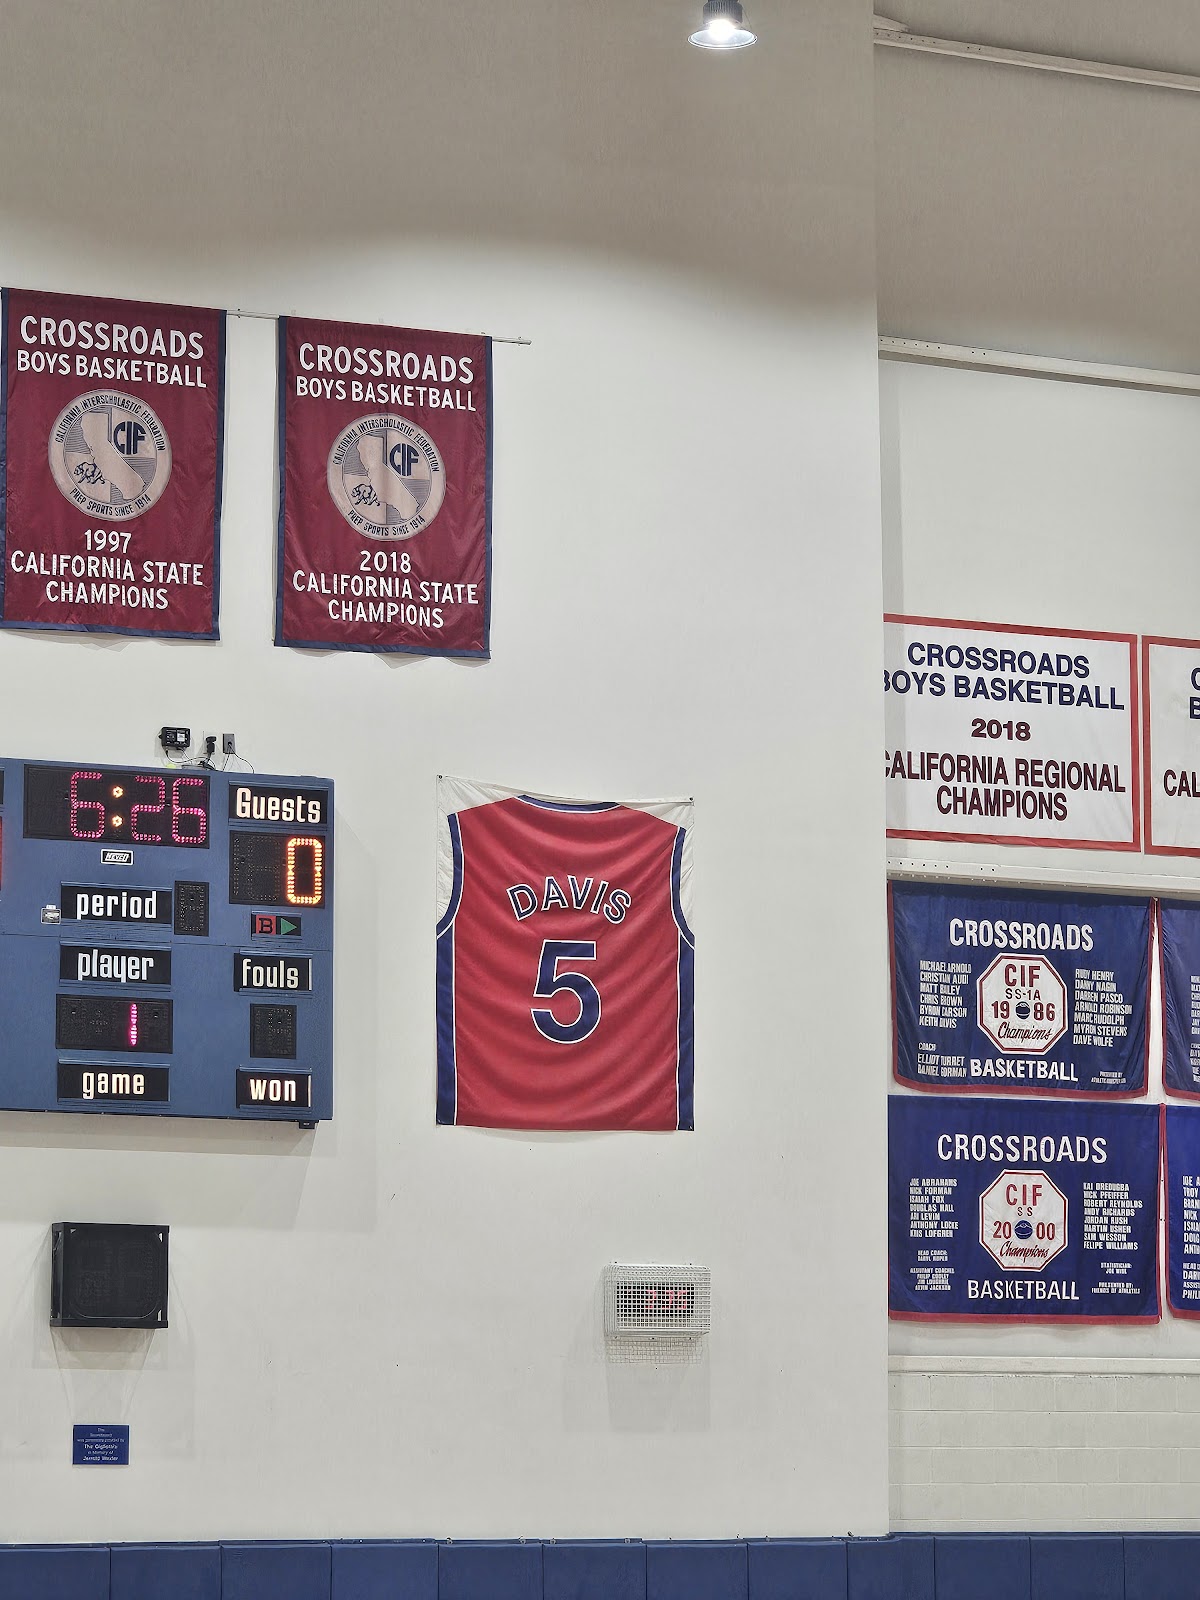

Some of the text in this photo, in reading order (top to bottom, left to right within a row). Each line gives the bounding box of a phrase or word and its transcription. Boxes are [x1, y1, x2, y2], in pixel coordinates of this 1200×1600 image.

[20, 315, 204, 359] CROSSROADS
[17, 349, 206, 388] BOYS BASKETBALL
[299, 343, 474, 384] CROSSROADS
[296, 375, 477, 411] BOYS BASKETBALL
[55, 395, 165, 451] CALIFORNIA INTERSCHOLASTIC FEDERATION
[114, 421, 146, 455] CIF
[333, 419, 440, 472] CALIFORNIA INTERSCHOLASTIC FEDERATION
[390, 443, 419, 476] CIF
[70, 488, 152, 516] PREP SPORTS SINCE 1914
[348, 510, 426, 536] PREP SPORTS SINCE 1914
[84, 529, 131, 554] 1997
[11, 550, 204, 586] CALIFORNIA STATE
[360, 551, 412, 574] 2018
[46, 580, 168, 610] CHAMPIONS
[292, 569, 479, 605] CALIFORNIA STATE
[328, 600, 444, 629] CHAMPIONS
[908, 642, 1090, 678] CROSSROADS
[954, 675, 1125, 710] BASKETBALL
[971, 718, 1031, 741] 2018
[1015, 758, 1126, 793] REGIONAL
[71, 771, 206, 844] 6:26
[236, 788, 321, 824] Guests
[937, 785, 1068, 821] CHAMPIONS
[287, 838, 322, 904] 0
[77, 891, 157, 920] period
[507, 875, 631, 924] DAVIS
[258, 917, 273, 935] B
[950, 918, 1094, 952] CROSSROADS
[78, 950, 154, 983] player
[243, 959, 298, 988] fouls
[920, 960, 972, 974] MICHAEL ARNOLD
[920, 972, 950, 983] CHRISTIAN
[1005, 964, 1041, 987] CIF
[1075, 969, 1114, 981] RUDY HENRY
[530, 939, 602, 1044] 5
[920, 982, 960, 995] MATT BAILEY
[1005, 988, 1041, 1001] SS-1A
[1075, 980, 1095, 990] DANNY
[920, 993, 962, 1006] CHRIS BROWN
[1075, 990, 1123, 1004] DARREN PASCO
[1075, 1001, 1132, 1015] ARNOLD ROBINSON
[919, 1016, 957, 1028] KEITH DAVIS
[920, 1005, 967, 1018] BYRON CARSON
[991, 1001, 1055, 1021] 19 86
[1074, 1012, 1125, 1025] MARC RUDOLPH
[998, 1021, 1054, 1043] Champions
[1073, 1035, 1114, 1047] DAVE WOLFE
[1074, 1024, 1127, 1037] MYRON STEVENS
[919, 1043, 936, 1051] COACH
[918, 1053, 940, 1065] ELLIOT
[918, 1064, 940, 1077] DANIEL
[971, 1059, 1078, 1082] BASKETBALL
[83, 1072, 145, 1099] game
[250, 1078, 296, 1102] won
[938, 1134, 1108, 1164] CROSSROADS
[910, 1178, 957, 1187] JOE ABRAHAMS
[925, 1187, 952, 1195] FORMAN
[1183, 1187, 1198, 1198] TROY
[932, 1196, 945, 1204] FOX
[1006, 1184, 1042, 1206] CIF
[1084, 1199, 1143, 1208] ROBERT REYNOLDS
[910, 1204, 954, 1212] DOUGLAS HALL
[1103, 1208, 1135, 1217] RICHARDS
[911, 1221, 938, 1229] ANTHONY
[993, 1221, 1055, 1240] 20 00
[1084, 1225, 1107, 1233] MARTIN
[1111, 1217, 1128, 1225] RUSH
[925, 1230, 954, 1238] LOFGREN
[1084, 1233, 1096, 1241] SAM
[1000, 1241, 1049, 1263] Champions
[1084, 1241, 1138, 1250] FELIPE WILLIAMS
[968, 1280, 1079, 1300] BASKETBALL
